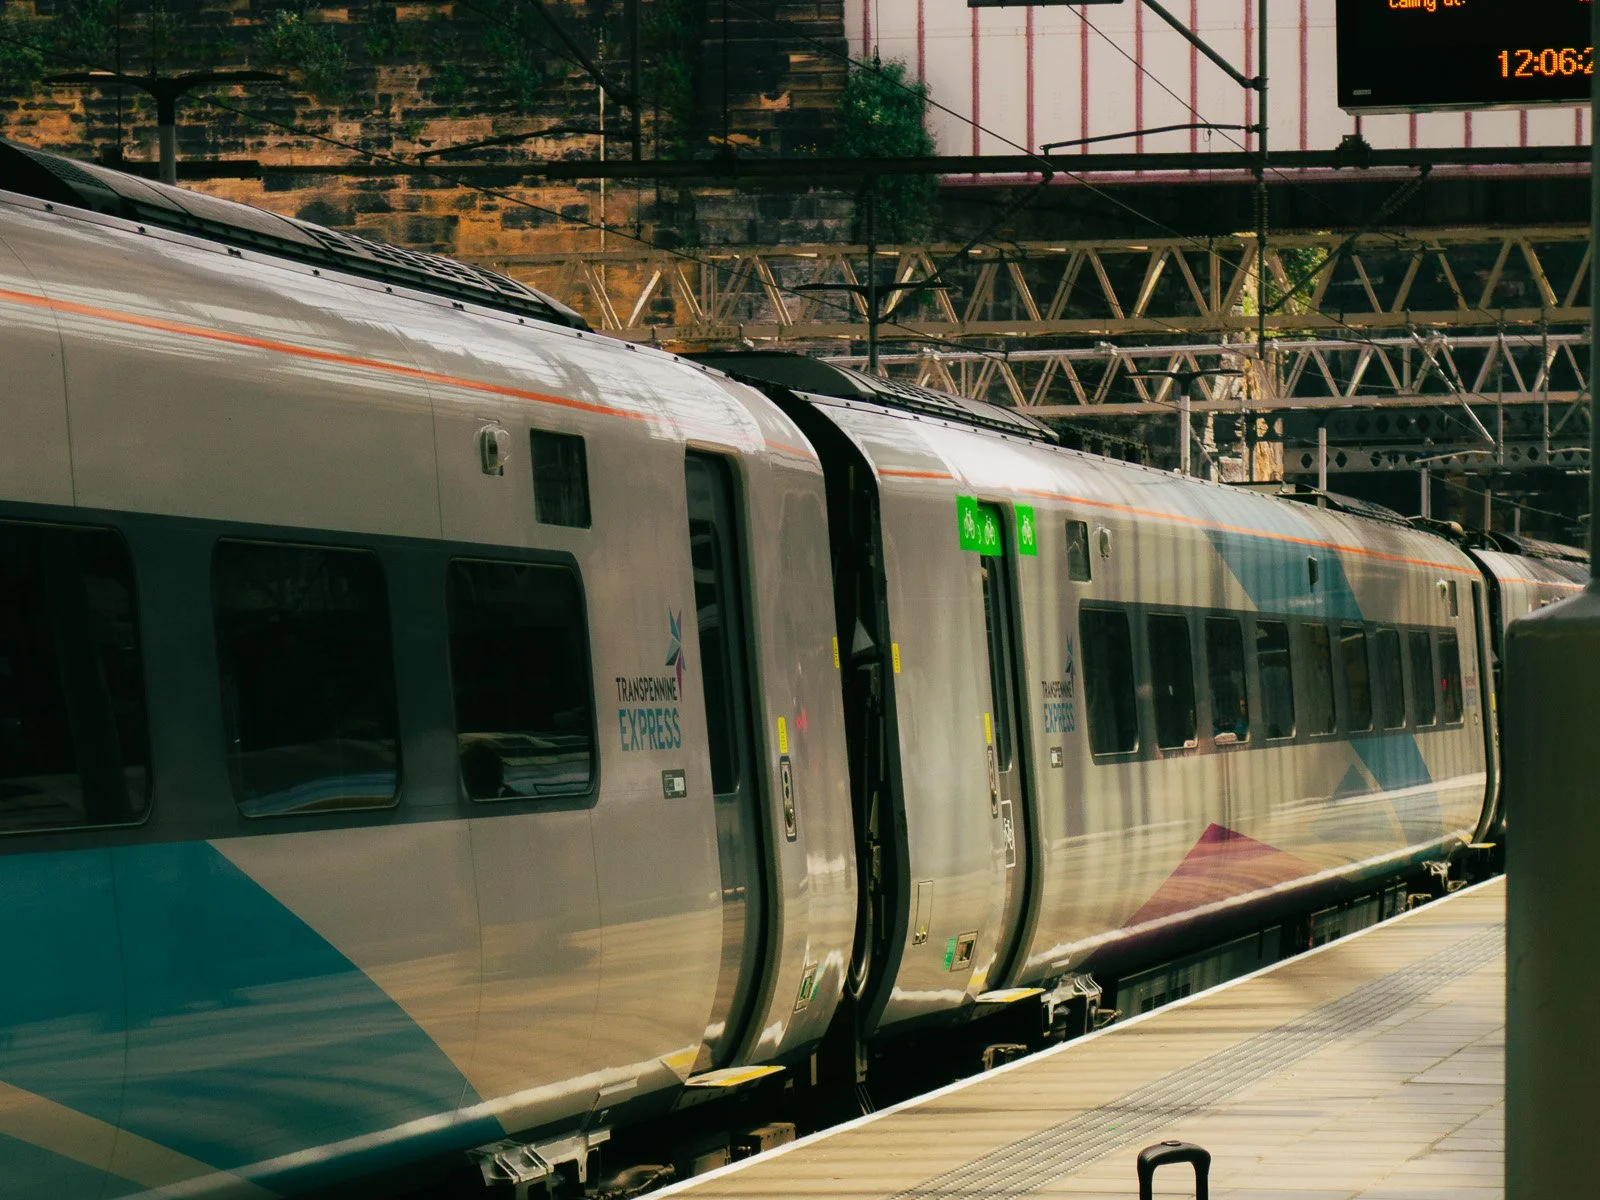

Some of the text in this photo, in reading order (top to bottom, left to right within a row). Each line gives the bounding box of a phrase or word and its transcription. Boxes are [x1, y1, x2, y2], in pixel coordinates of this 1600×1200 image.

[615, 677, 678, 701] TRANSPENNINE
[618, 708, 682, 752] EXPRESS
[1043, 703, 1075, 733] EXPRESS
